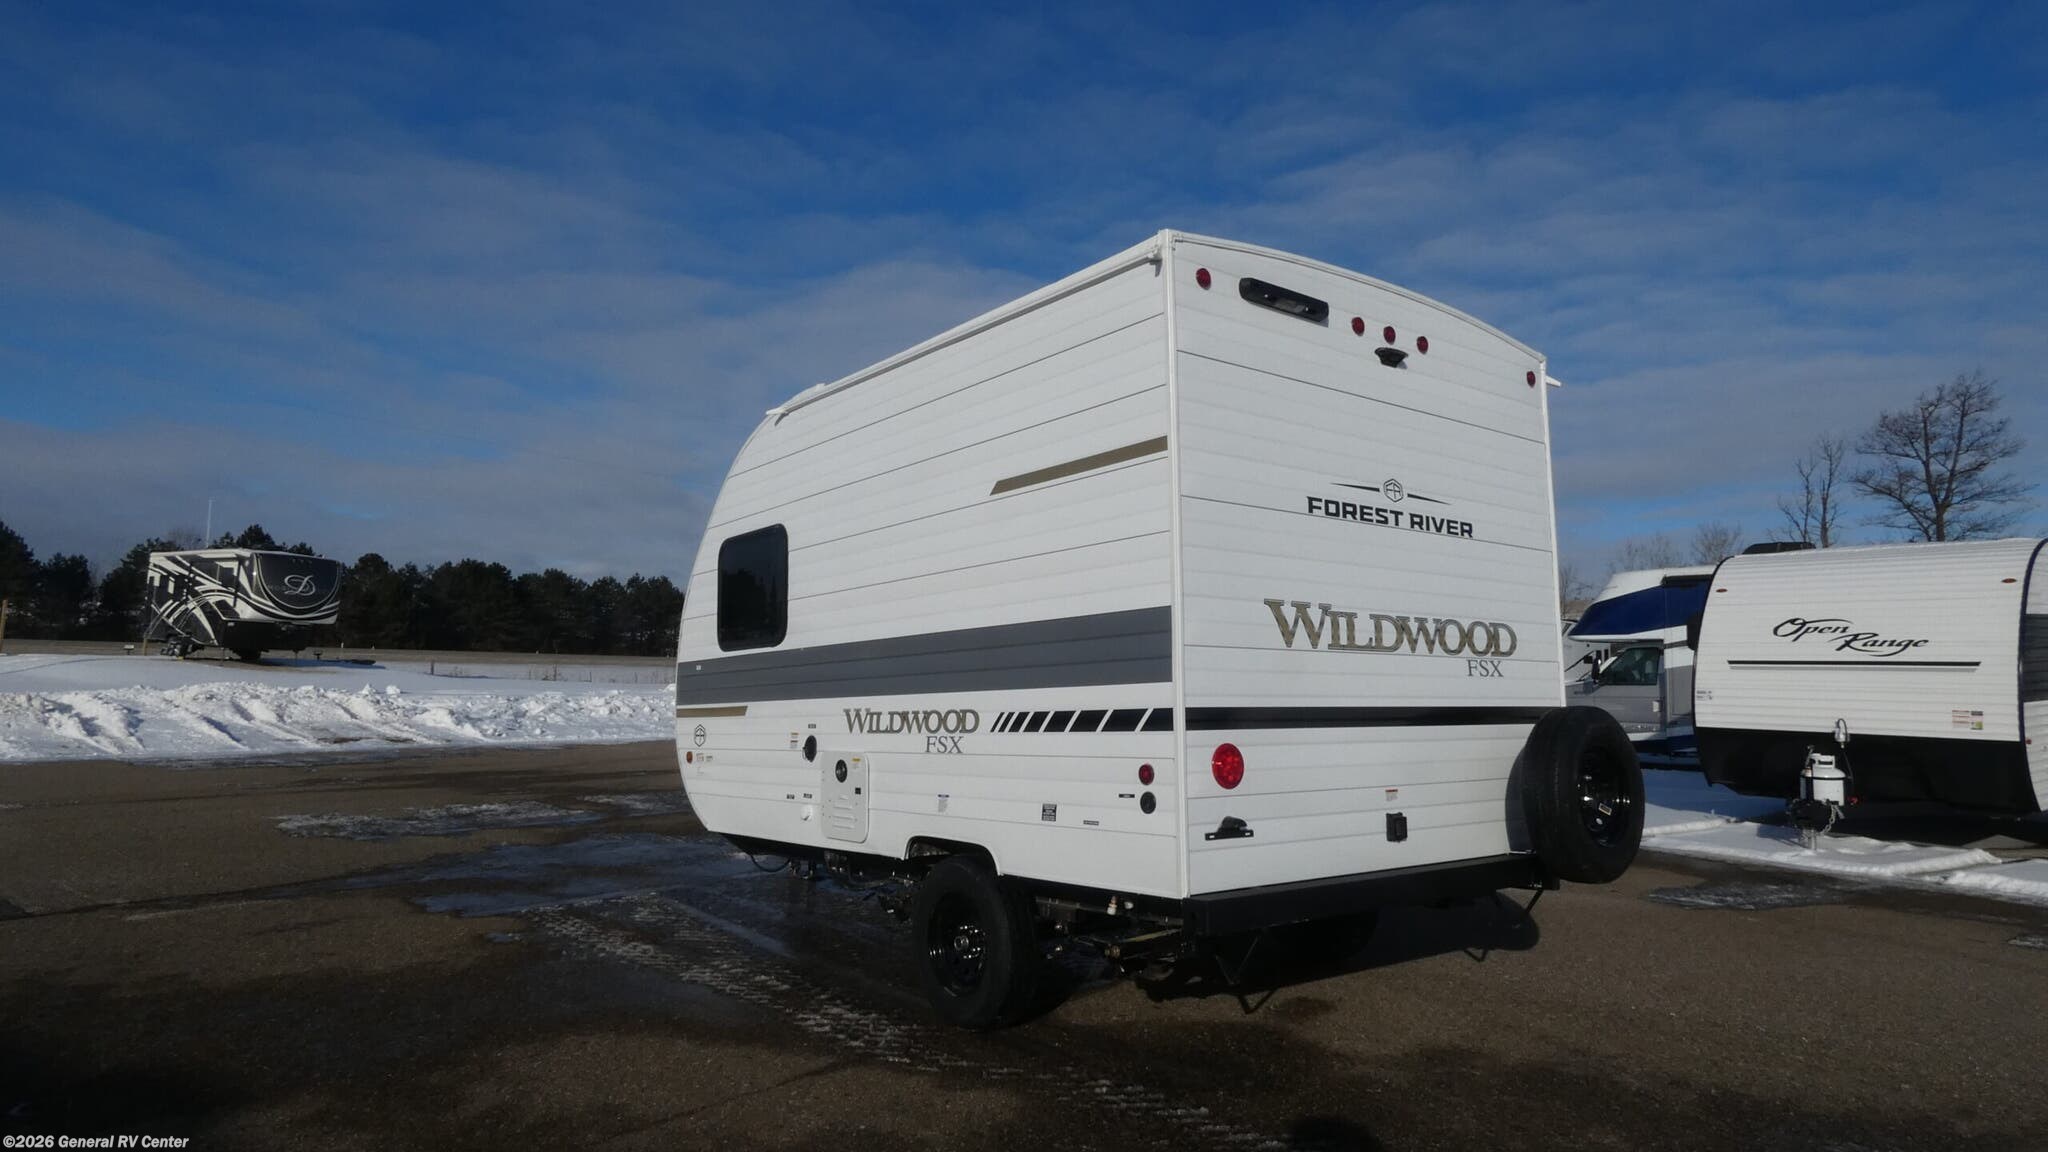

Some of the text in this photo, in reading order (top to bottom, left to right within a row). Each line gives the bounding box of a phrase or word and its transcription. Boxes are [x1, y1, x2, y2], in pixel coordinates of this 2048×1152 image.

[1307, 496, 1473, 538] FOREST RIVER
[1264, 598, 1517, 657] WILDWOOD
[1773, 617, 1854, 643] Open
[1827, 632, 1929, 657] Range
[1467, 659, 1504, 678] FSX
[843, 708, 980, 734] WILDWOOD
[925, 735, 964, 754] FSX
